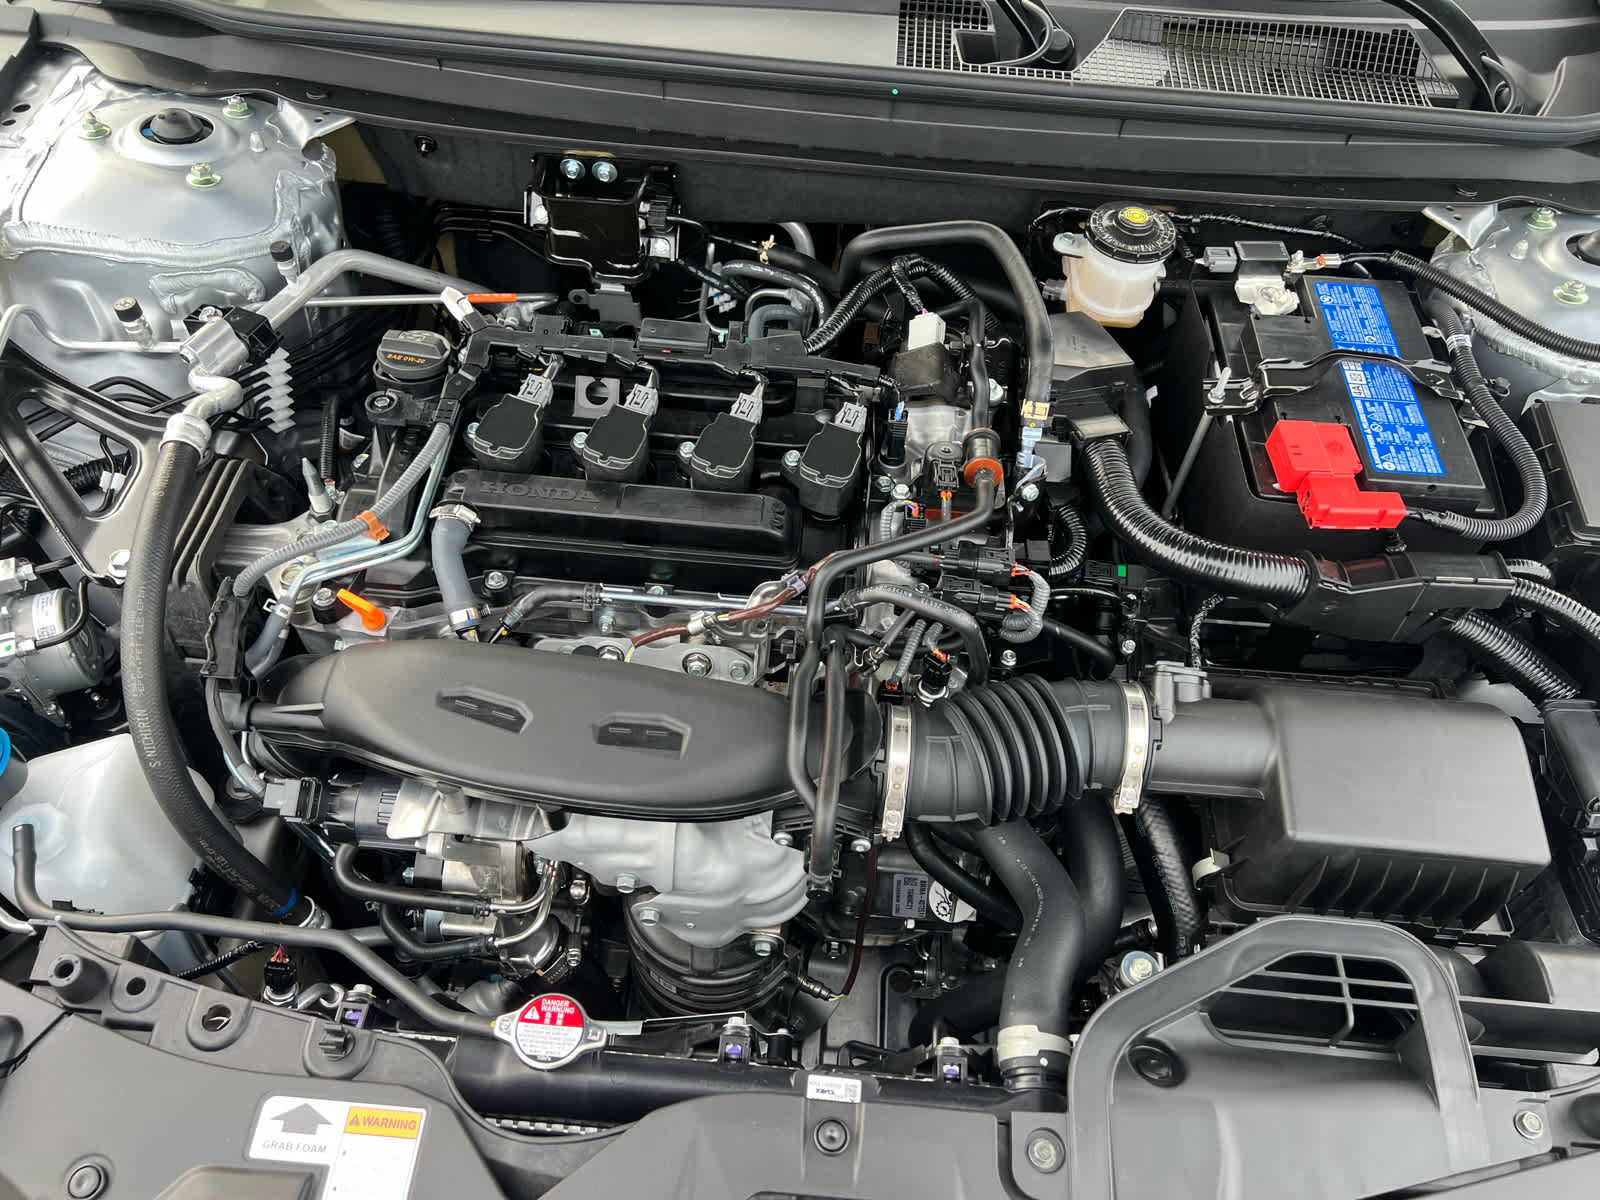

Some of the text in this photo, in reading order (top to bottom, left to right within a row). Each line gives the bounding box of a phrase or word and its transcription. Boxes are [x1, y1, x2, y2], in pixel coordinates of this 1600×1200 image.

[480, 480, 600, 504] HONDA
[541, 998, 570, 1007] DANGER
[362, 1115, 417, 1131] WARNING
